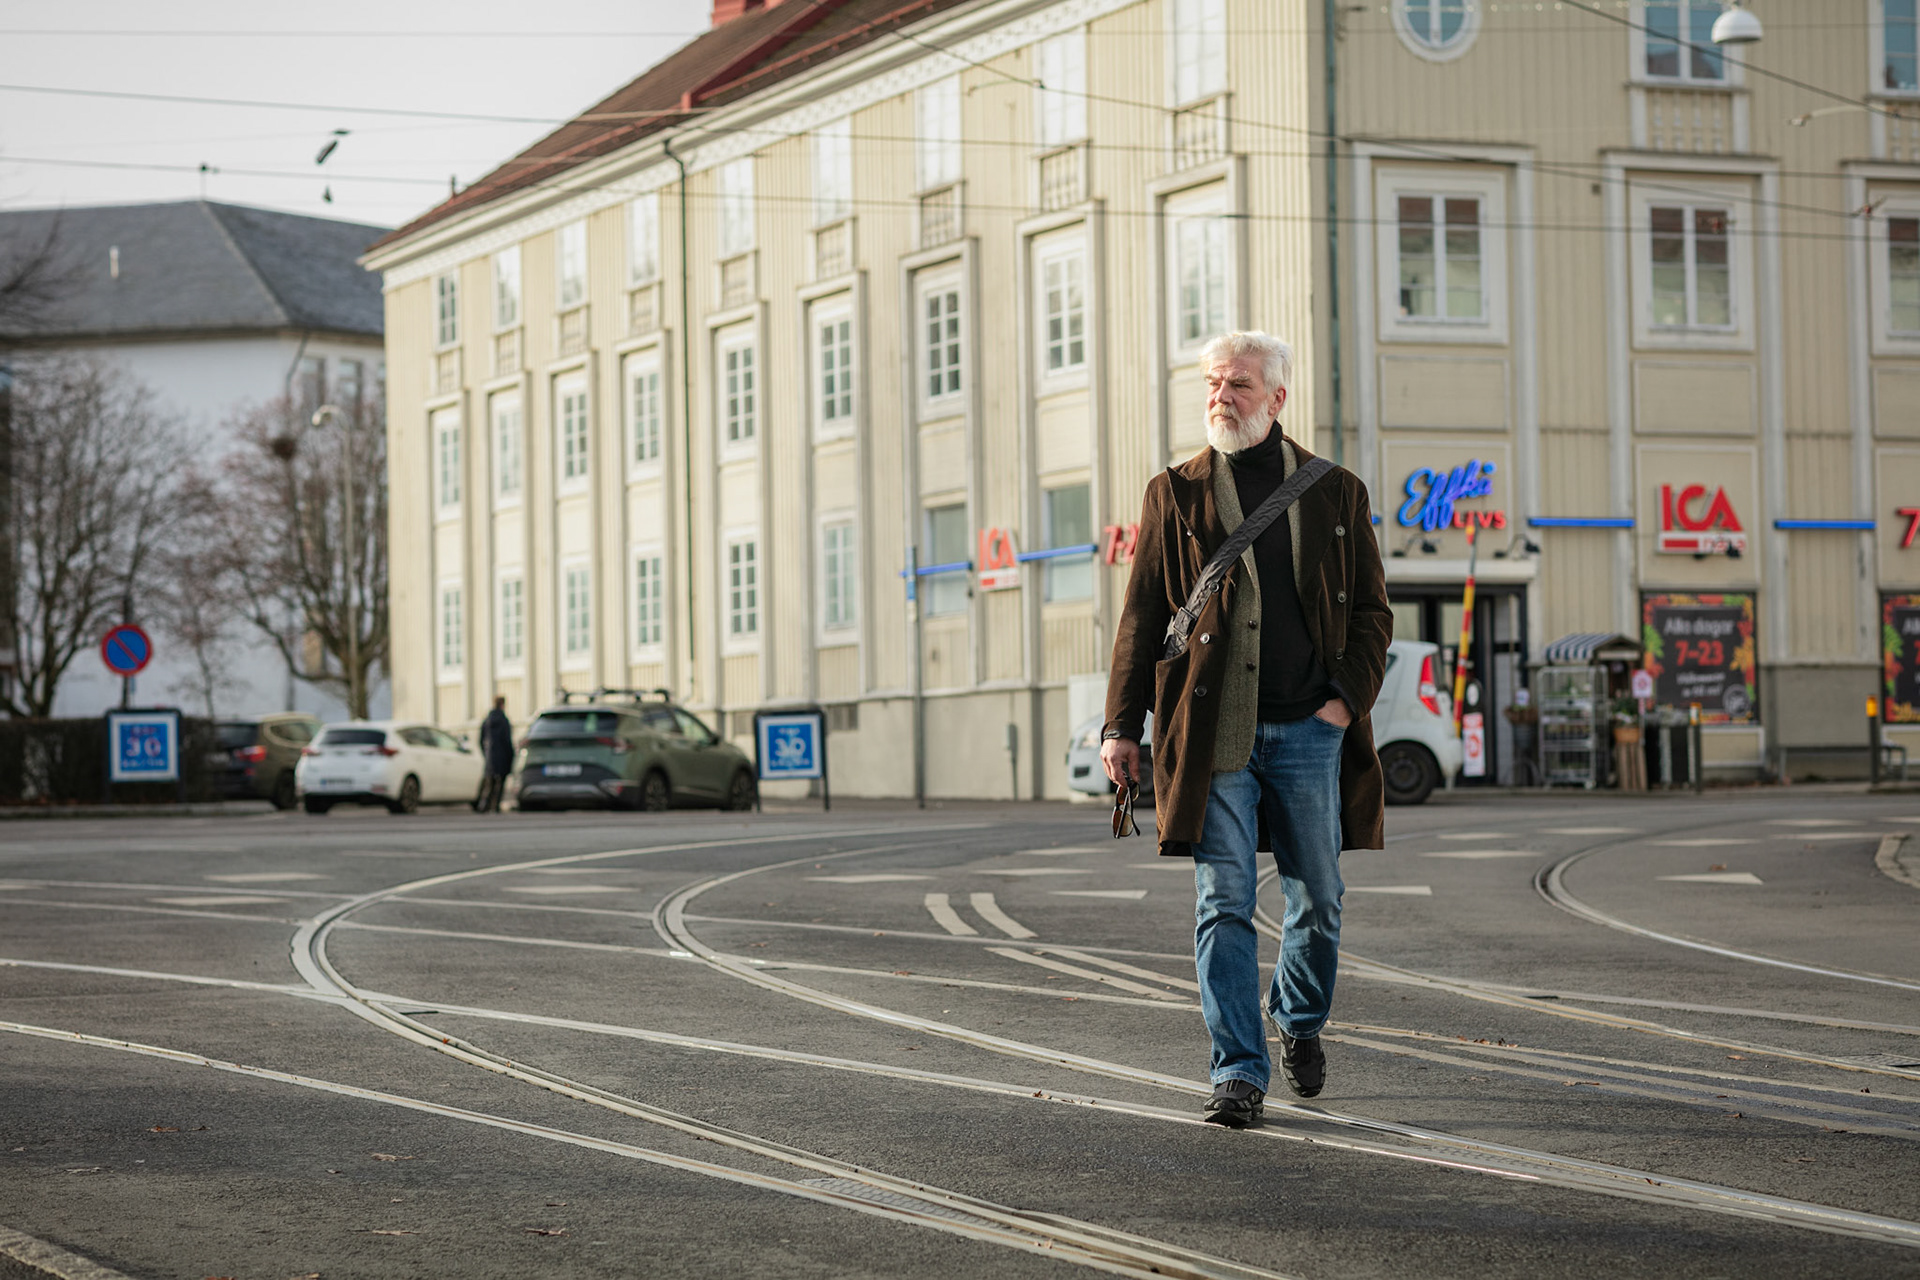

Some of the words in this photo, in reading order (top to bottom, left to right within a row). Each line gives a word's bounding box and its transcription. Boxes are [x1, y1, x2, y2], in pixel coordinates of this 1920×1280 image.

[1453, 510, 1506, 529] LIVS
[1661, 484, 1744, 532] ICA
[977, 527, 1016, 571] ICA
[1675, 640, 1725, 666] 7-23
[125, 736, 162, 757] 30
